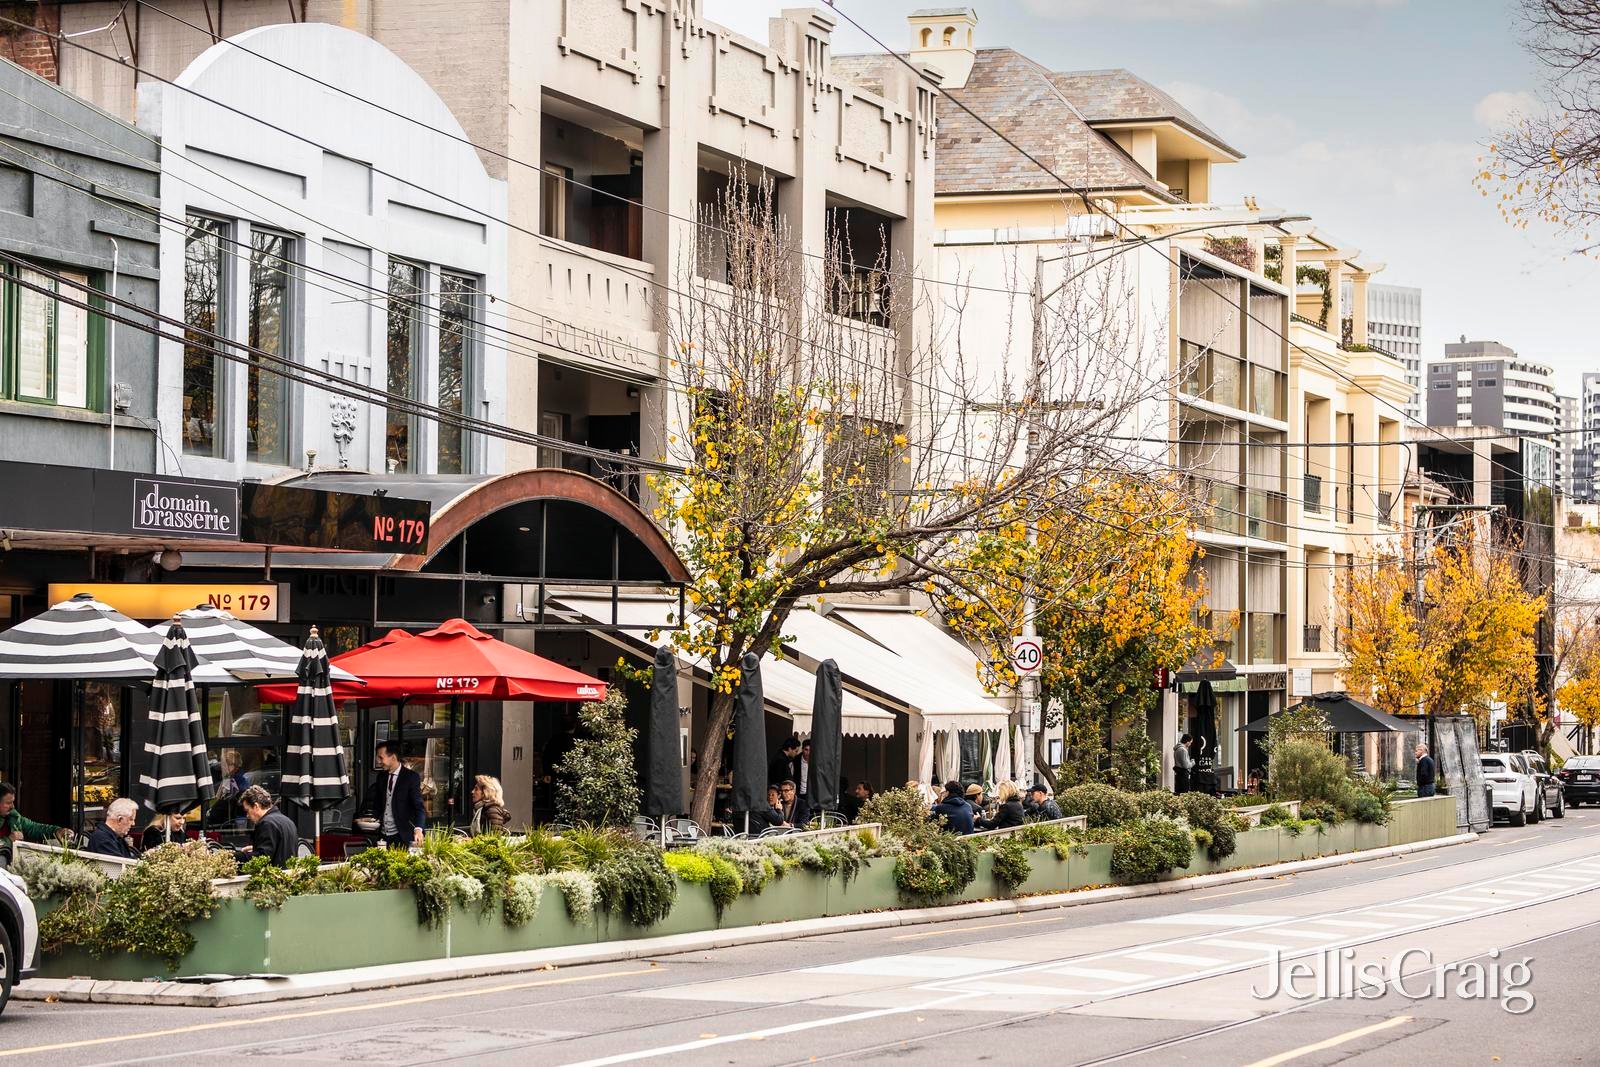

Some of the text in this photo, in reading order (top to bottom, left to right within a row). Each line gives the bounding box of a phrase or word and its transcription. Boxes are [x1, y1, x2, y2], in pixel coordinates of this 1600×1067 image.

[541, 316, 647, 366] BOTANICAL
[145, 483, 211, 513] domain
[140, 499, 230, 531] brasserie
[398, 519, 425, 544] 179
[238, 594, 271, 611] 179
[1017, 648, 1039, 664] 40
[456, 677, 480, 689] 179
